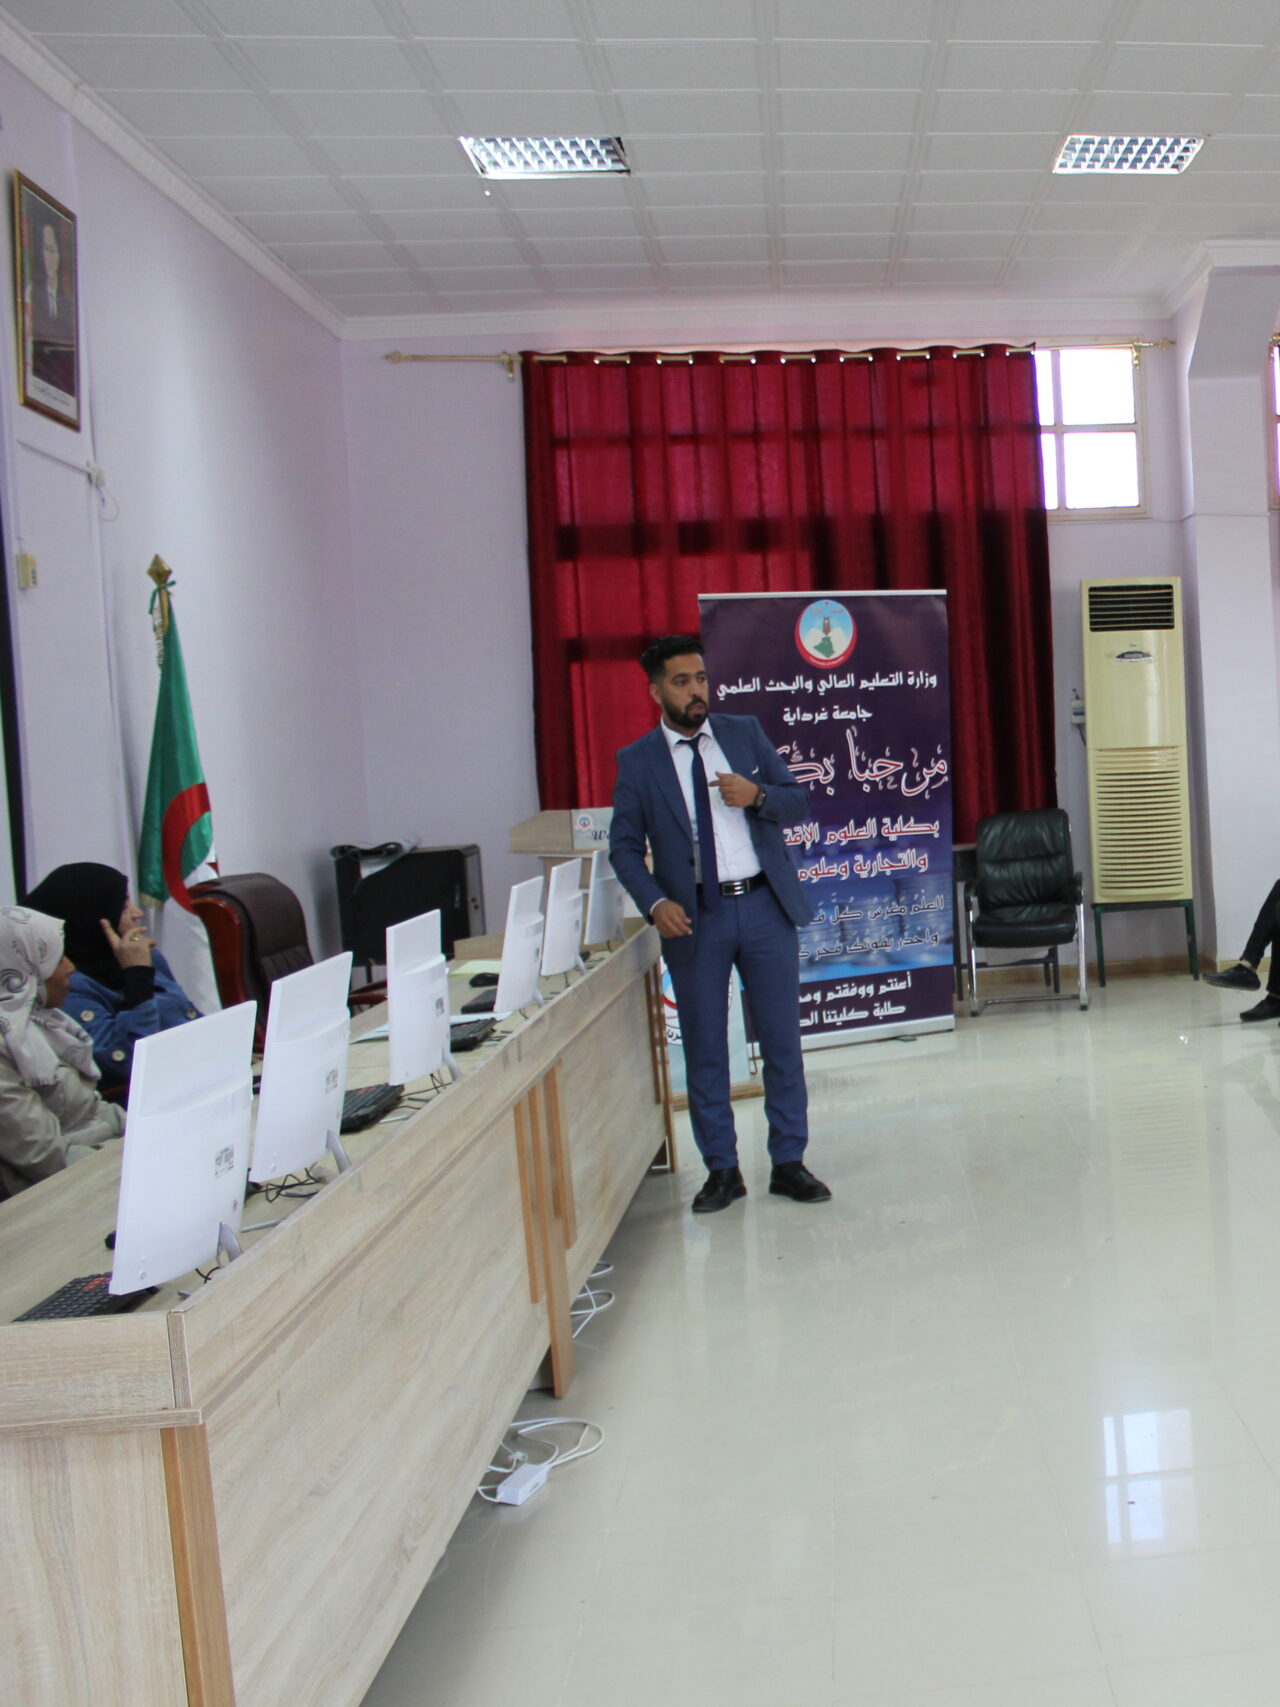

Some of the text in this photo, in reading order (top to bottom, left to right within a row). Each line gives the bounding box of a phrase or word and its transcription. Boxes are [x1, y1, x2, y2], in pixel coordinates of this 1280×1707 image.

[716, 671, 938, 701] وزارة التعليم العالي والبحث العلمي
[783, 704, 873, 726] جامعة غرداية
[776, 744, 835, 796] بك
[783, 815, 940, 850] بكلية العلوم الإقت
[798, 848, 929, 884] والتجارية وعلوم
[825, 983, 875, 1002] ووفقتم
[822, 1006, 870, 1026] كليتنا
[872, 1000, 907, 1020] طلبة
